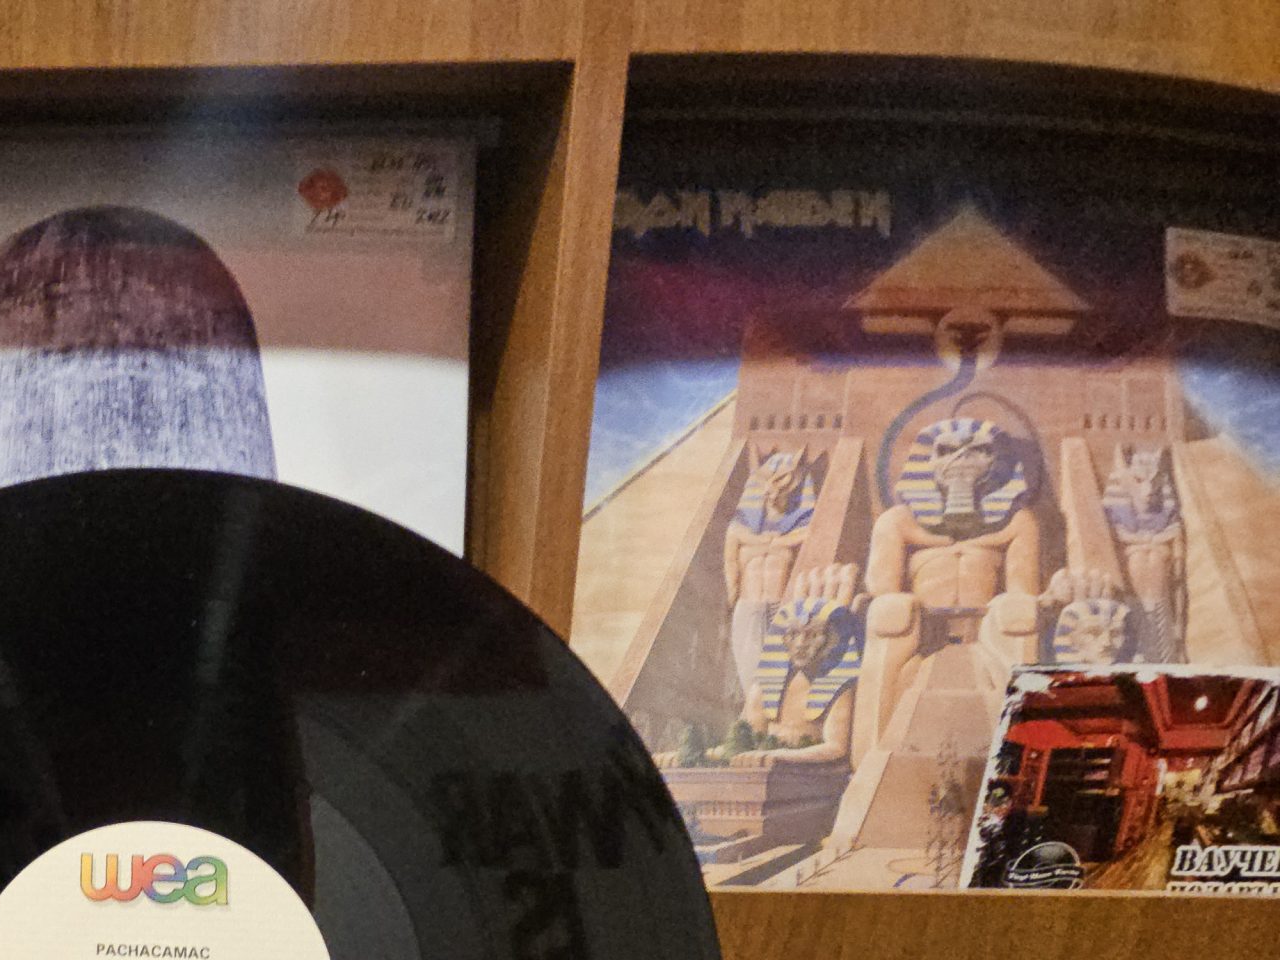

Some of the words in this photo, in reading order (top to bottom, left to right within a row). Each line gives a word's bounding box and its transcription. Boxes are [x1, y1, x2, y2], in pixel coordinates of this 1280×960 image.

[614, 189, 710, 238] RON
[80, 852, 229, 907] wea
[1175, 846, 1280, 876] ВАУЧЕ
[96, 943, 210, 960] PACHACAMAC
